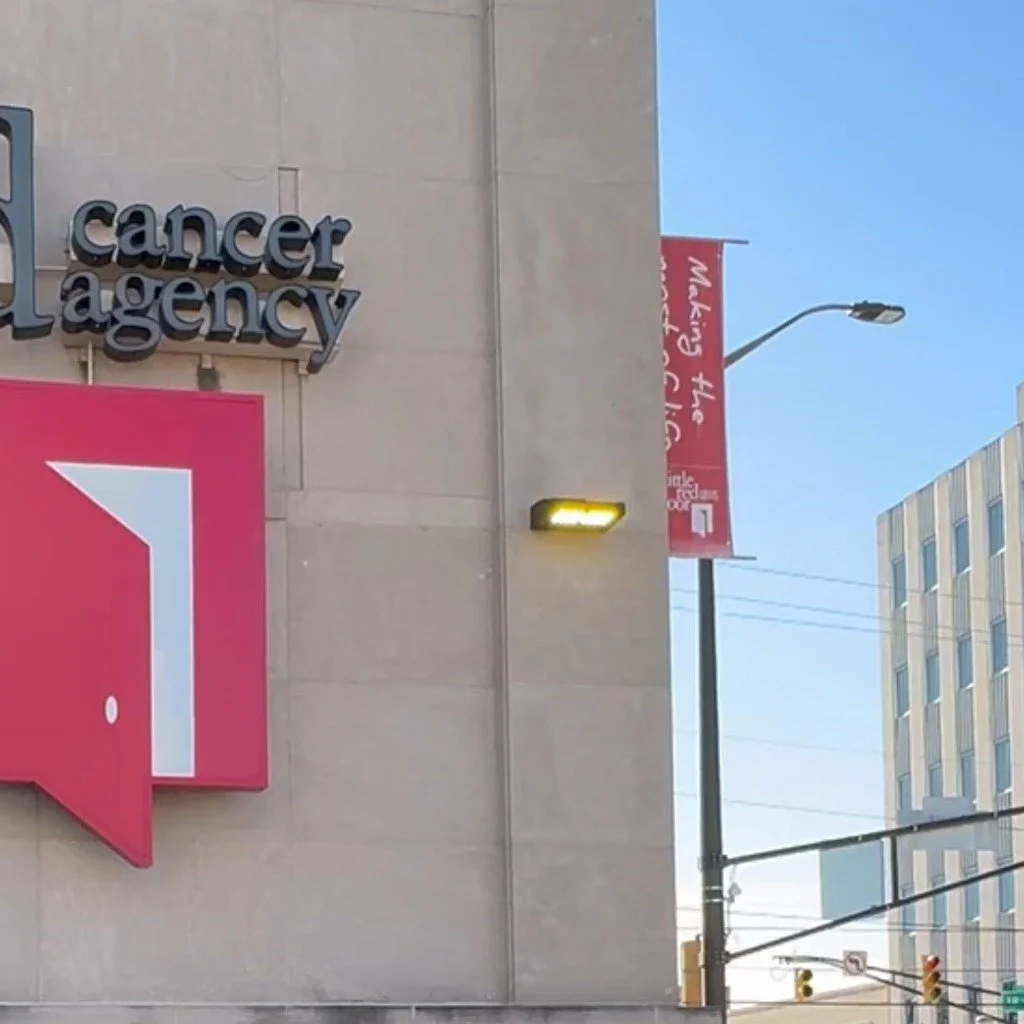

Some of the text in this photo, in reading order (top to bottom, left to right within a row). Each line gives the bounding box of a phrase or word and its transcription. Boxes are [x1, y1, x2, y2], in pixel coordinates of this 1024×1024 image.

[71, 199, 352, 281] cancer
[59, 270, 362, 375] agency
[677, 256, 716, 425] Making the
[666, 499, 691, 511] oor
